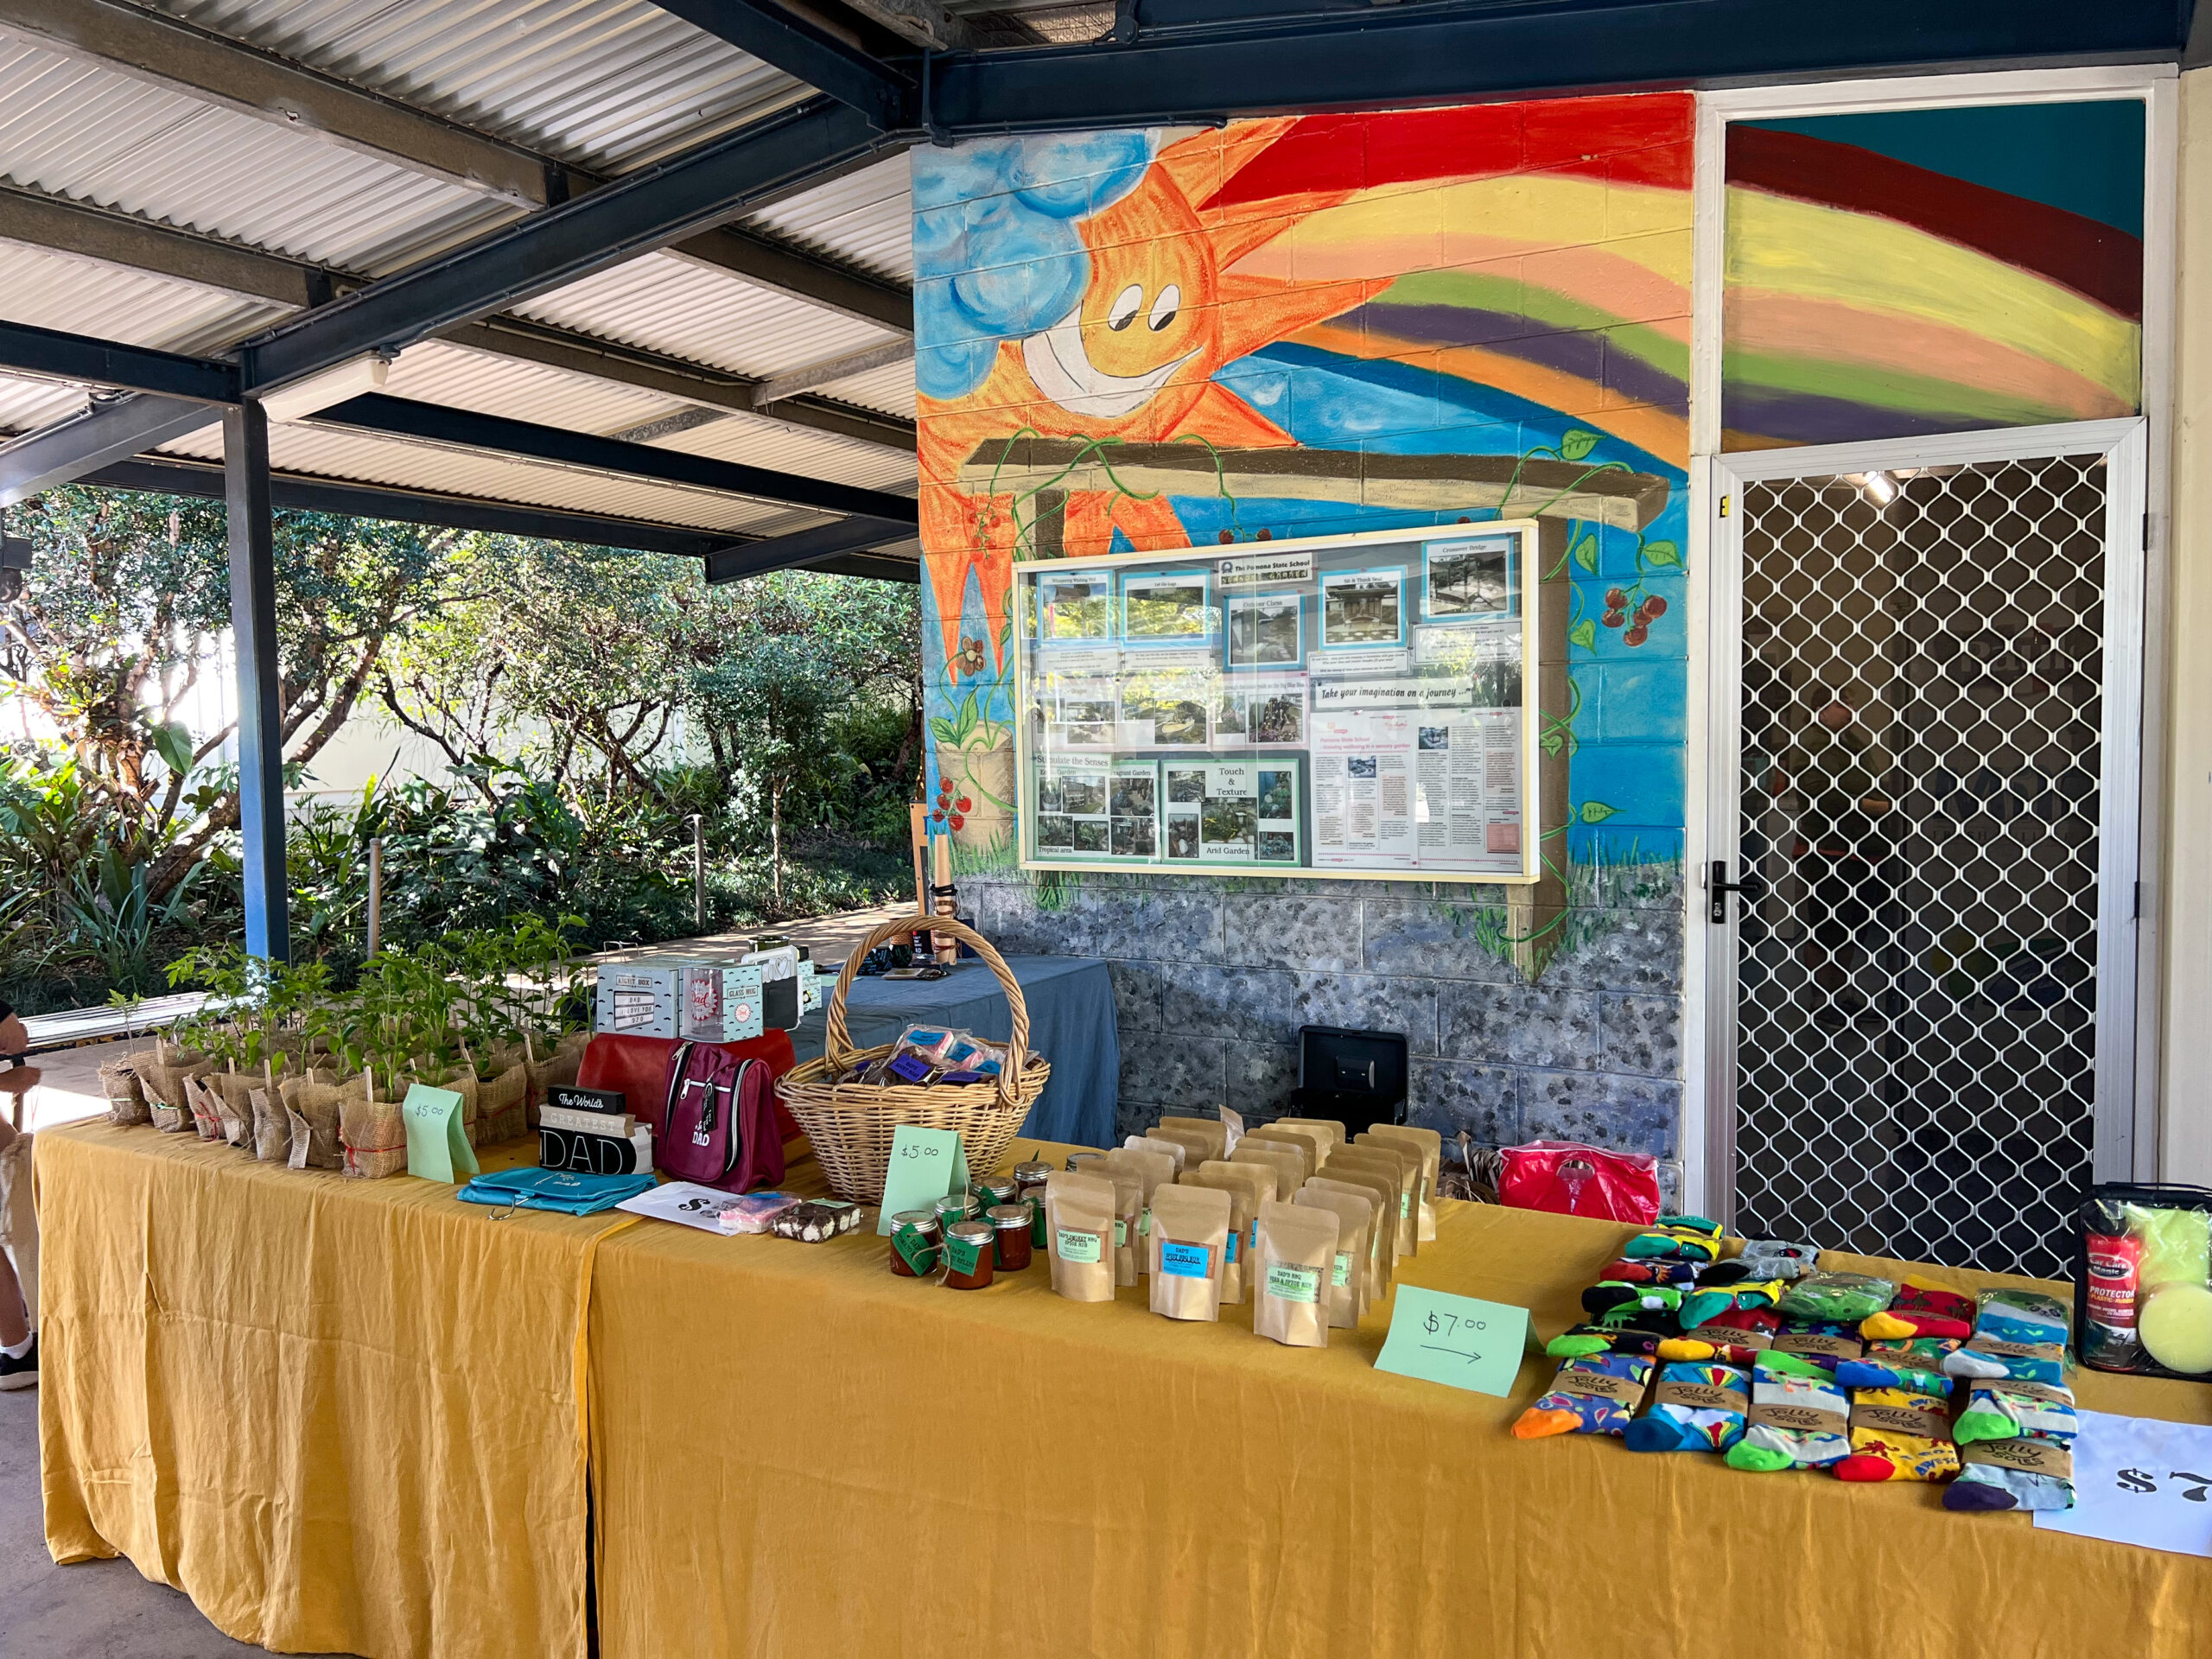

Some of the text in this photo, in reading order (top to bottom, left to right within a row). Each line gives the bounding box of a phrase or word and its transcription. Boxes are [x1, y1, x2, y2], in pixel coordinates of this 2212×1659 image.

[1289, 559, 1310, 568] School
[1321, 689, 1338, 699] Take
[1340, 688, 1357, 698] your
[1359, 686, 1405, 698] imagination
[1426, 687, 1457, 700] journey
[1071, 757, 1084, 766] the
[1084, 757, 1109, 767] Senses
[638, 977, 650, 986] BOX
[729, 988, 745, 997] GLASS
[559, 1093, 604, 1109] The World's
[550, 1113, 615, 1132] GREATEST
[691, 1130, 710, 1147] DAD
[540, 1129, 623, 1176] DAD
[2093, 1265, 2120, 1275] Magic
[2089, 1285, 2135, 1300] PROTECTOR
[1423, 1310, 1486, 1337] $7.00
